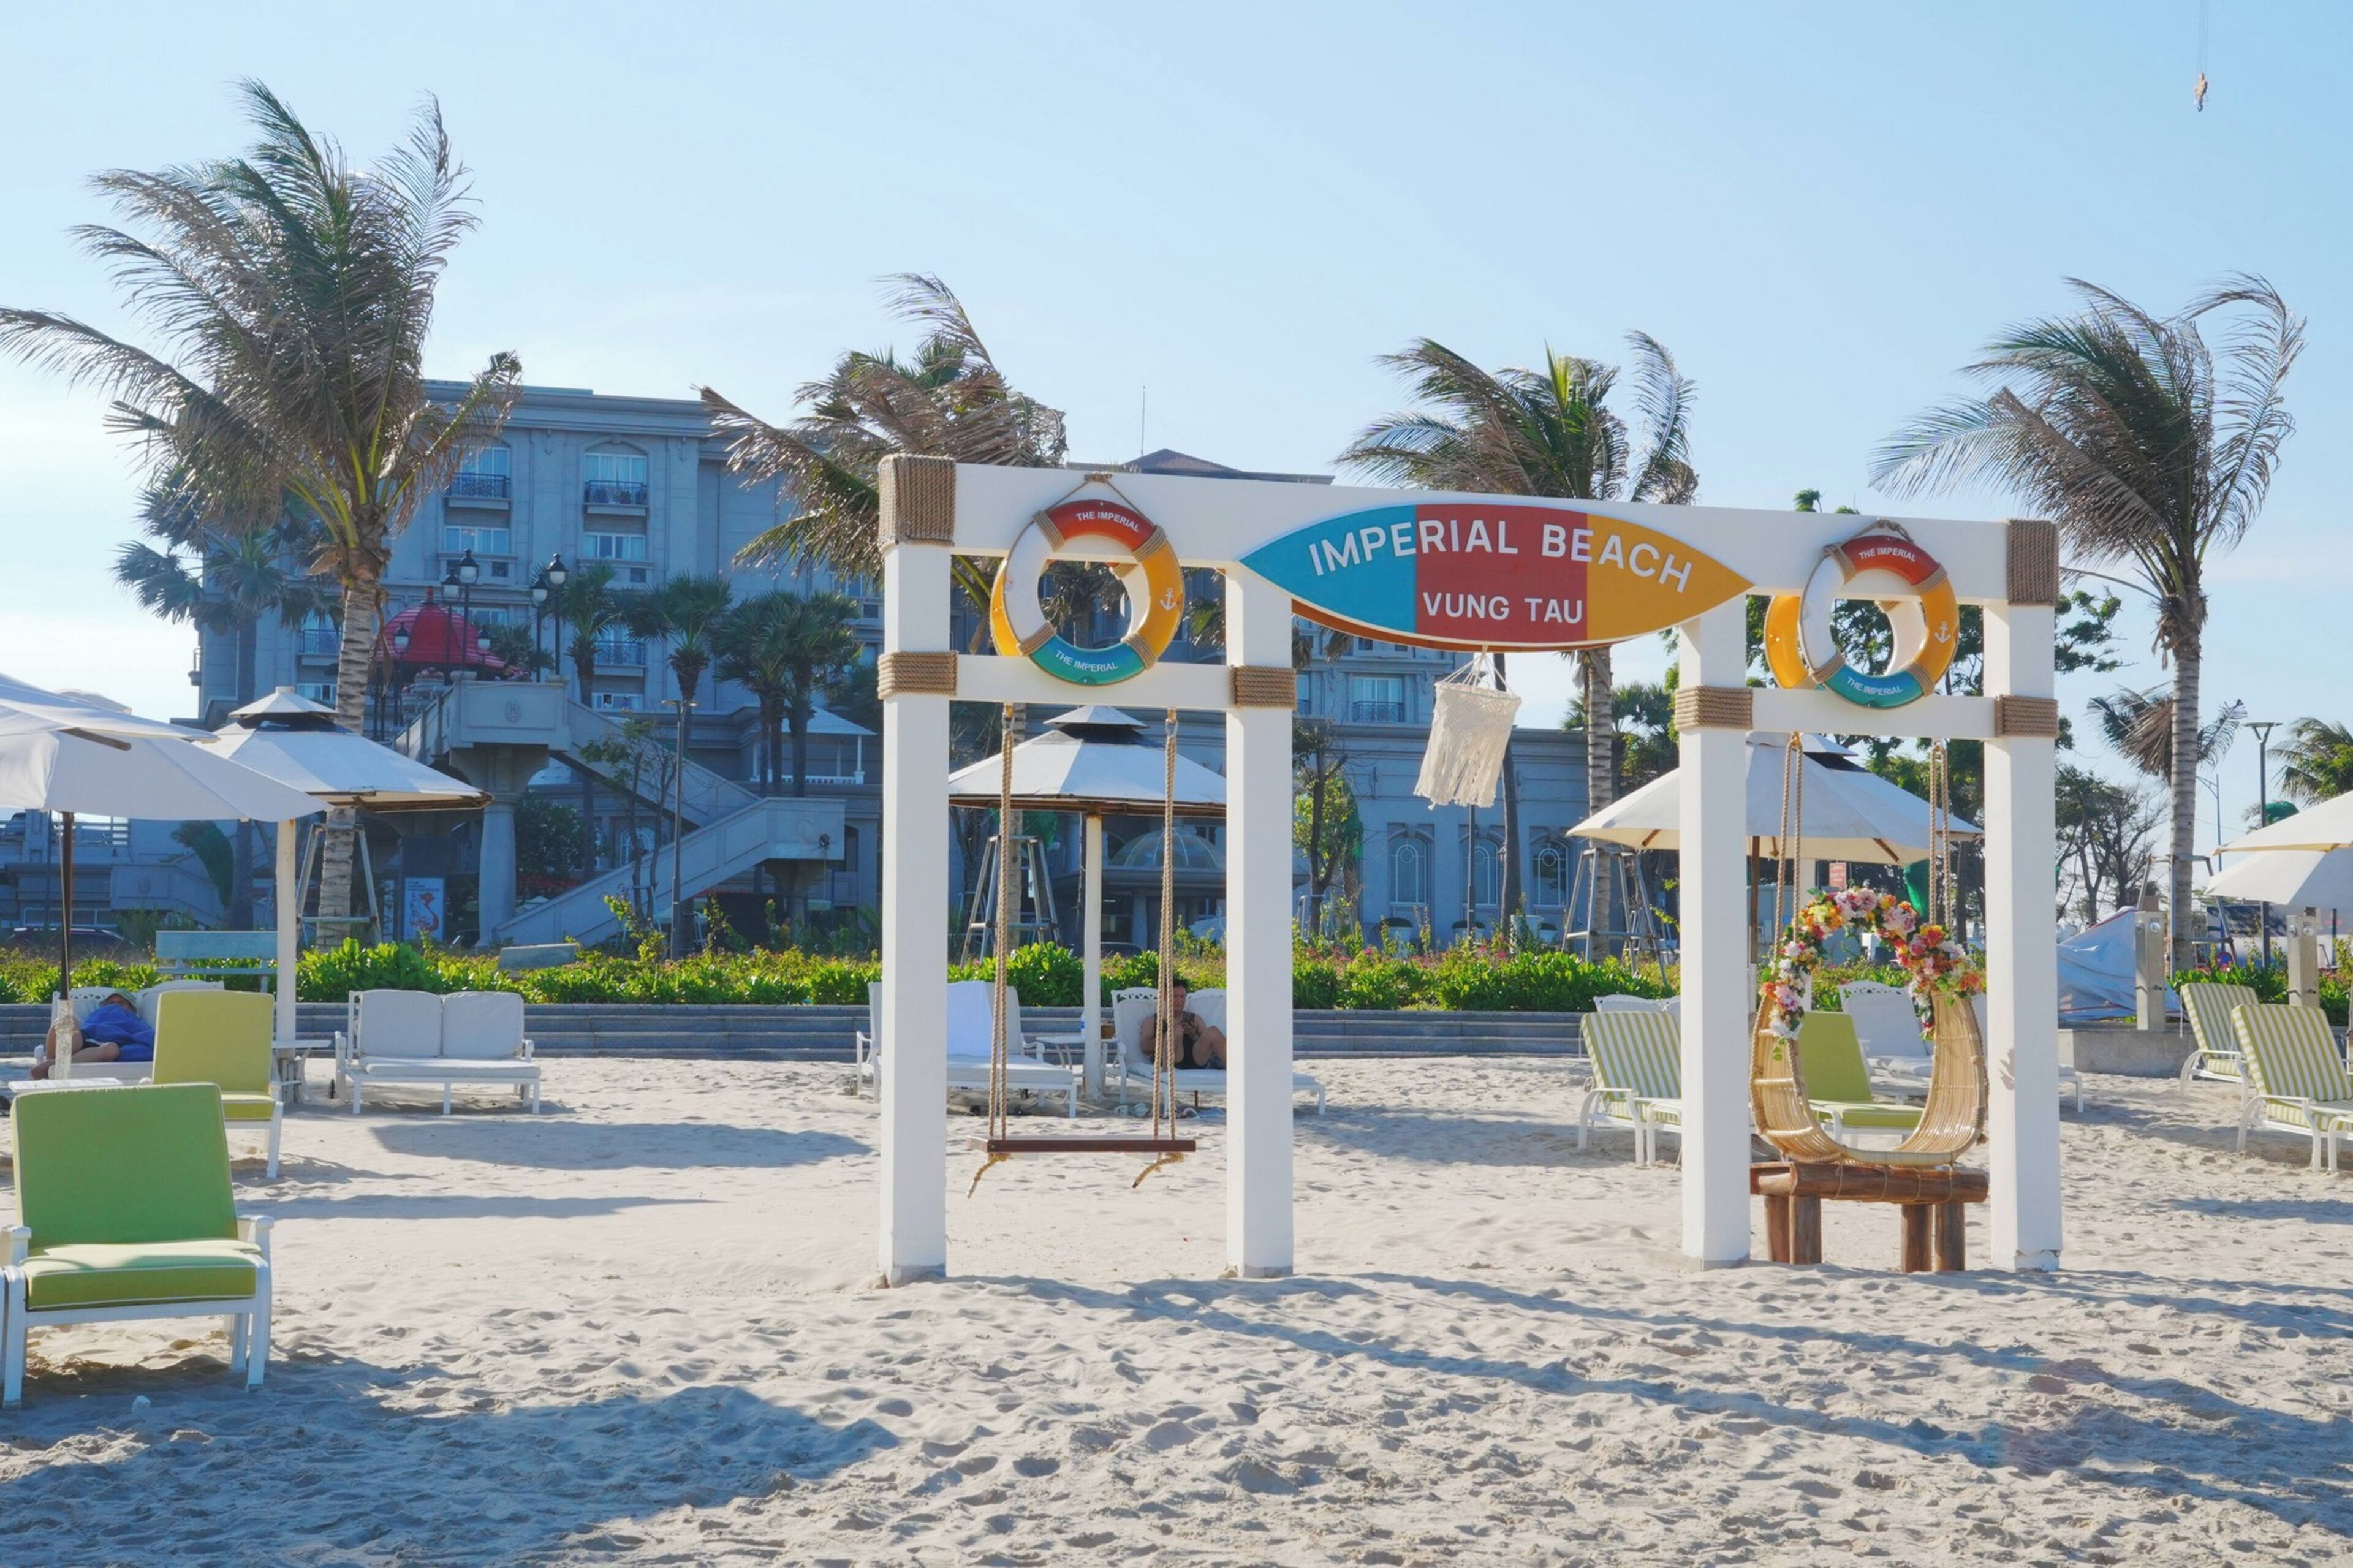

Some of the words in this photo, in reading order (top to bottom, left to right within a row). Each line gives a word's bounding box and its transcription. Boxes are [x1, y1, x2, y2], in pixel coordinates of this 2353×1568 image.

[1076, 511, 1095, 521] THE
[1097, 512, 1139, 532] IMPERIAL
[1308, 519, 1518, 577] IMPERIAL
[1542, 523, 1693, 593] BEACH
[1859, 548, 1876, 559] THE
[1877, 547, 1915, 562] IMPERIAL
[1422, 591, 1510, 621] VUNG
[1524, 597, 1583, 624] TAU
[1055, 650, 1074, 666] THE
[1074, 661, 1118, 672] IMPERIAL
[1847, 676, 1863, 691] THE
[1863, 685, 1903, 695] IMPERIAL
